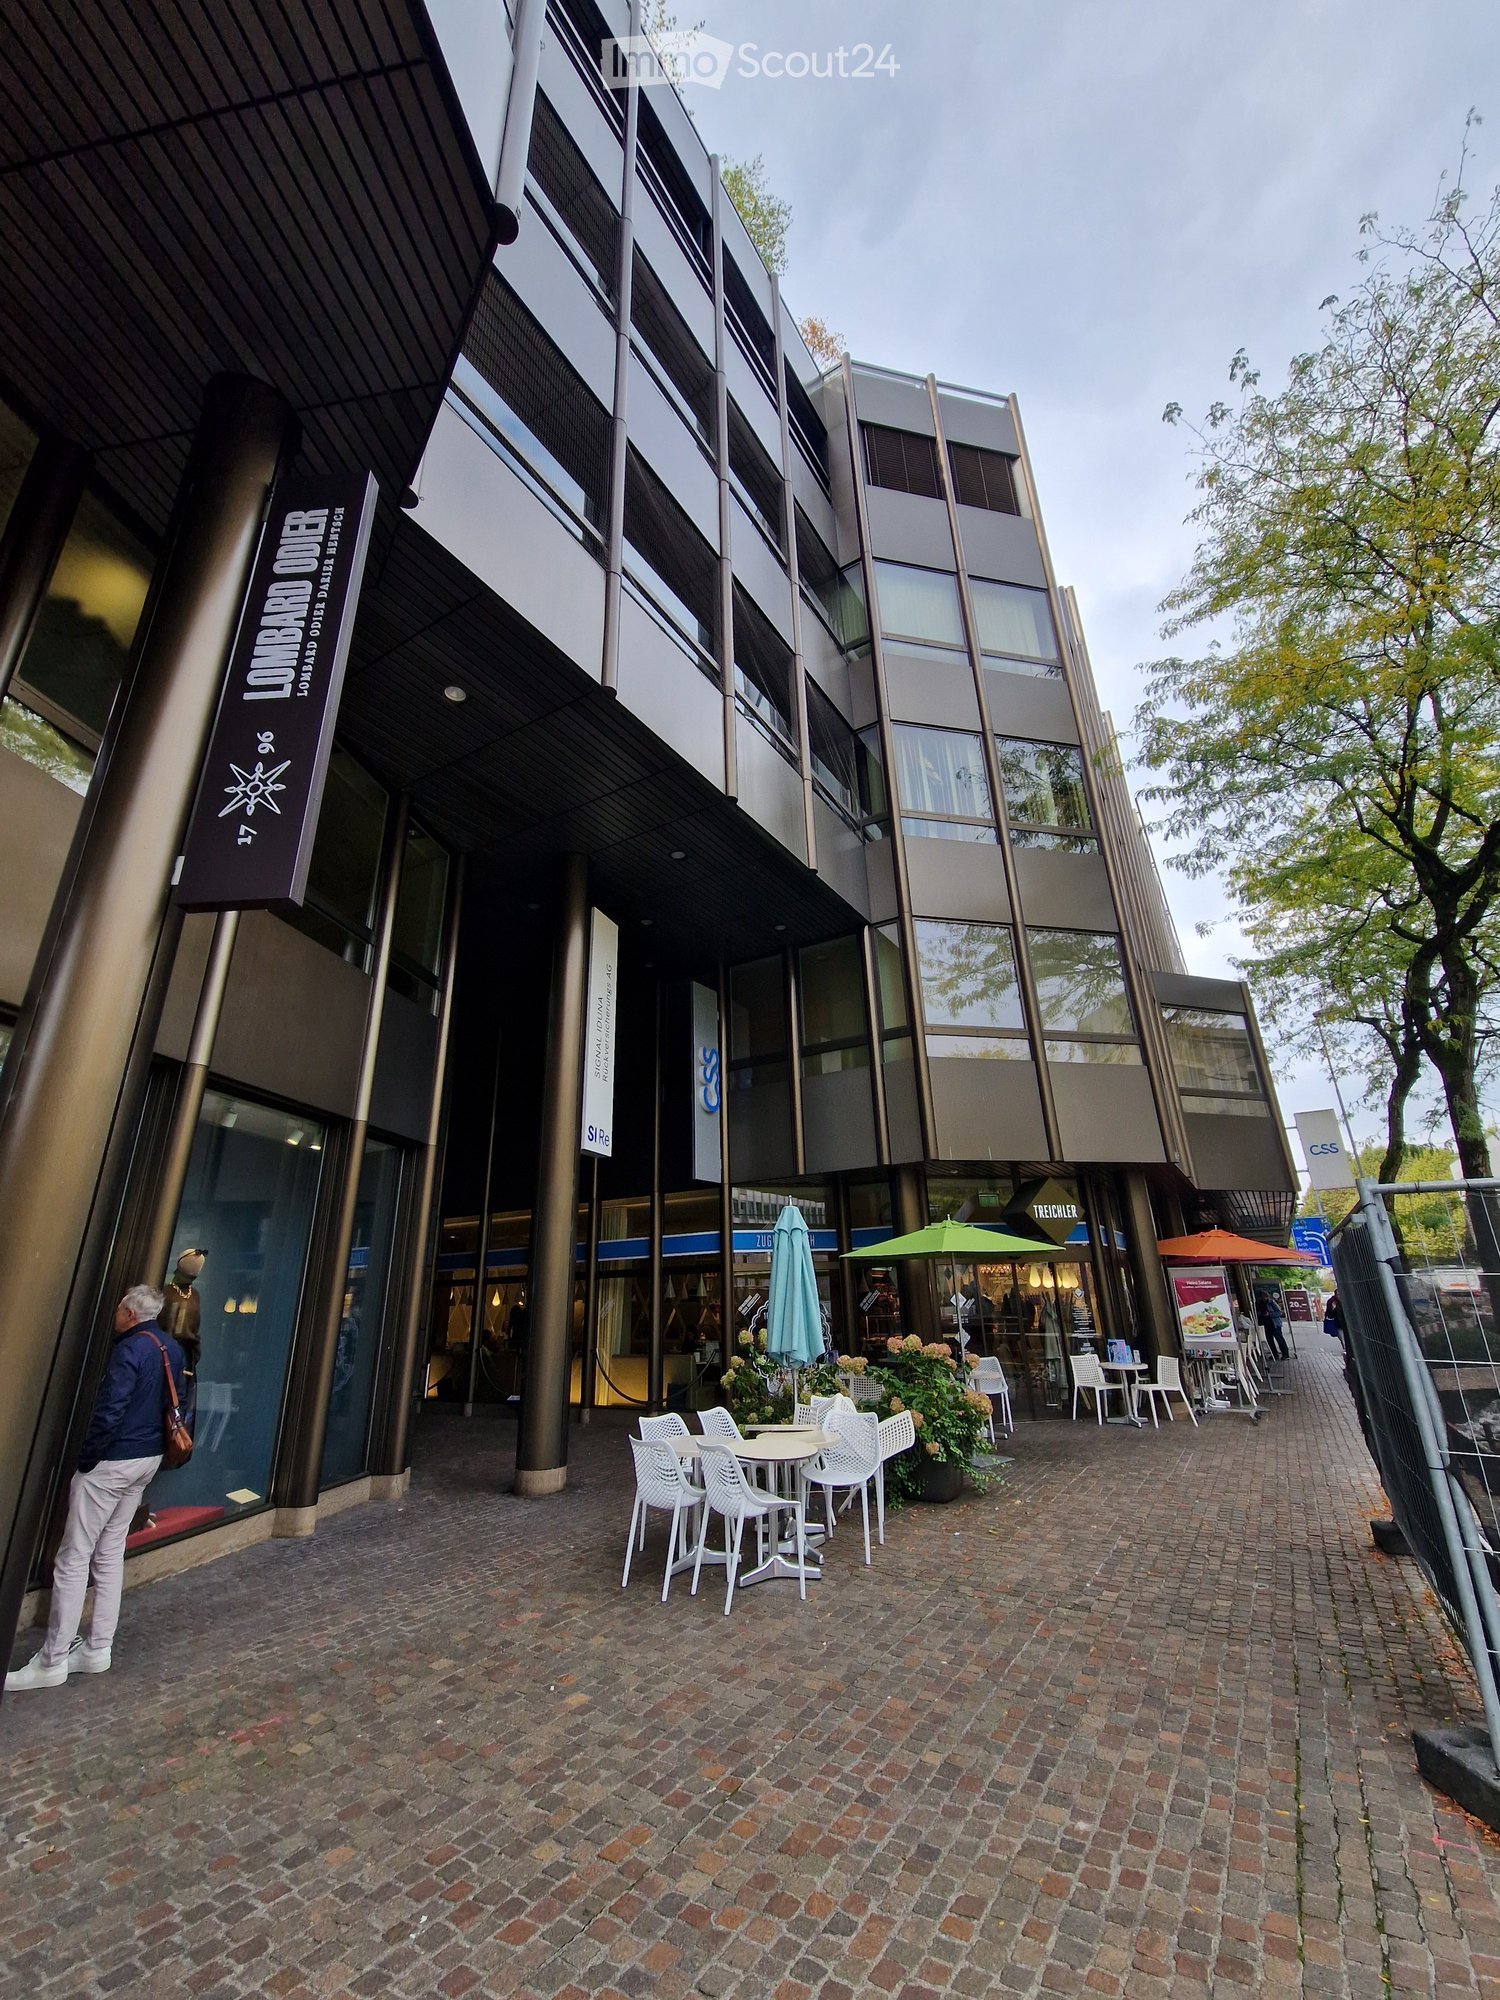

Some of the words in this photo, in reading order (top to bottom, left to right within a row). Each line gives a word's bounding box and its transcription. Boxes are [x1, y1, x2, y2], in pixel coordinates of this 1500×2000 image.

[273, 508, 329, 575] ODIER
[327, 507, 345, 555] HENTSCH
[317, 558, 335, 599] DARIER
[243, 580, 312, 700] LOMBARD
[309, 602, 327, 640] ODIER
[297, 647, 319, 697] LOMBARD
[257, 731, 275, 754] 96
[237, 824, 258, 846] 17
[605, 963, 613, 979] AG
[596, 996, 604, 1033] IDUNA
[602, 983, 612, 1083] Rückversicherungs
[594, 1036, 602, 1079] SIGNAL
[701, 1045, 721, 1114] CSS
[587, 1125, 597, 1143] SI
[599, 1128, 610, 1147] Re
[1309, 1142, 1339, 1155] CSS
[1032, 1204, 1078, 1219] TREICHLER
[756, 1235, 774, 1247] ZUG
